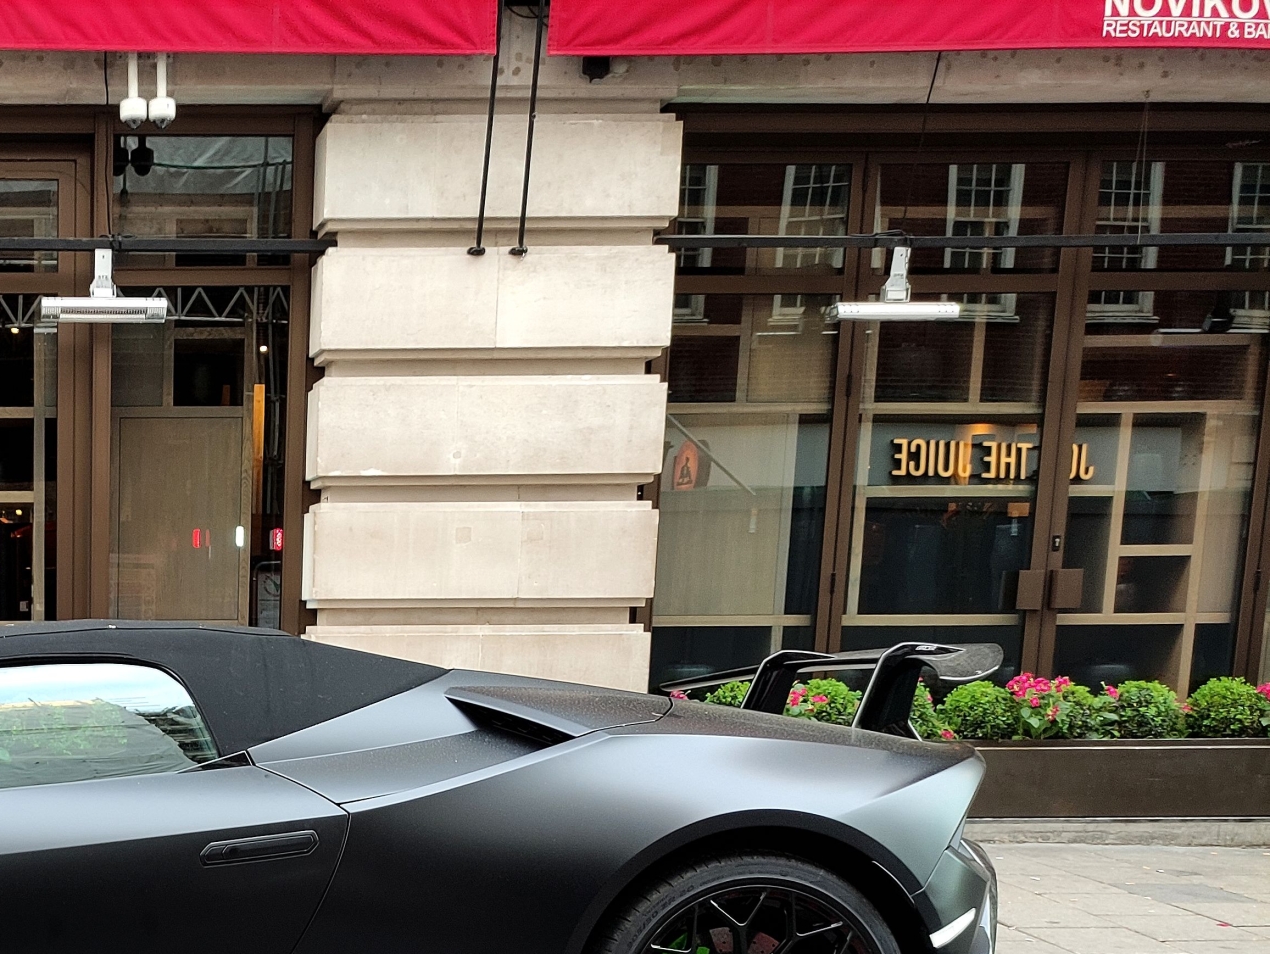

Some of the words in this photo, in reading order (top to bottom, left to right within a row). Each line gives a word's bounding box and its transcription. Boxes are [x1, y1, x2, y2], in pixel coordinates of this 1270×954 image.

[1104, 0, 1270, 19] NOVIKO
[1102, 20, 1226, 38] RESTAURANT
[1227, 21, 1241, 38] &
